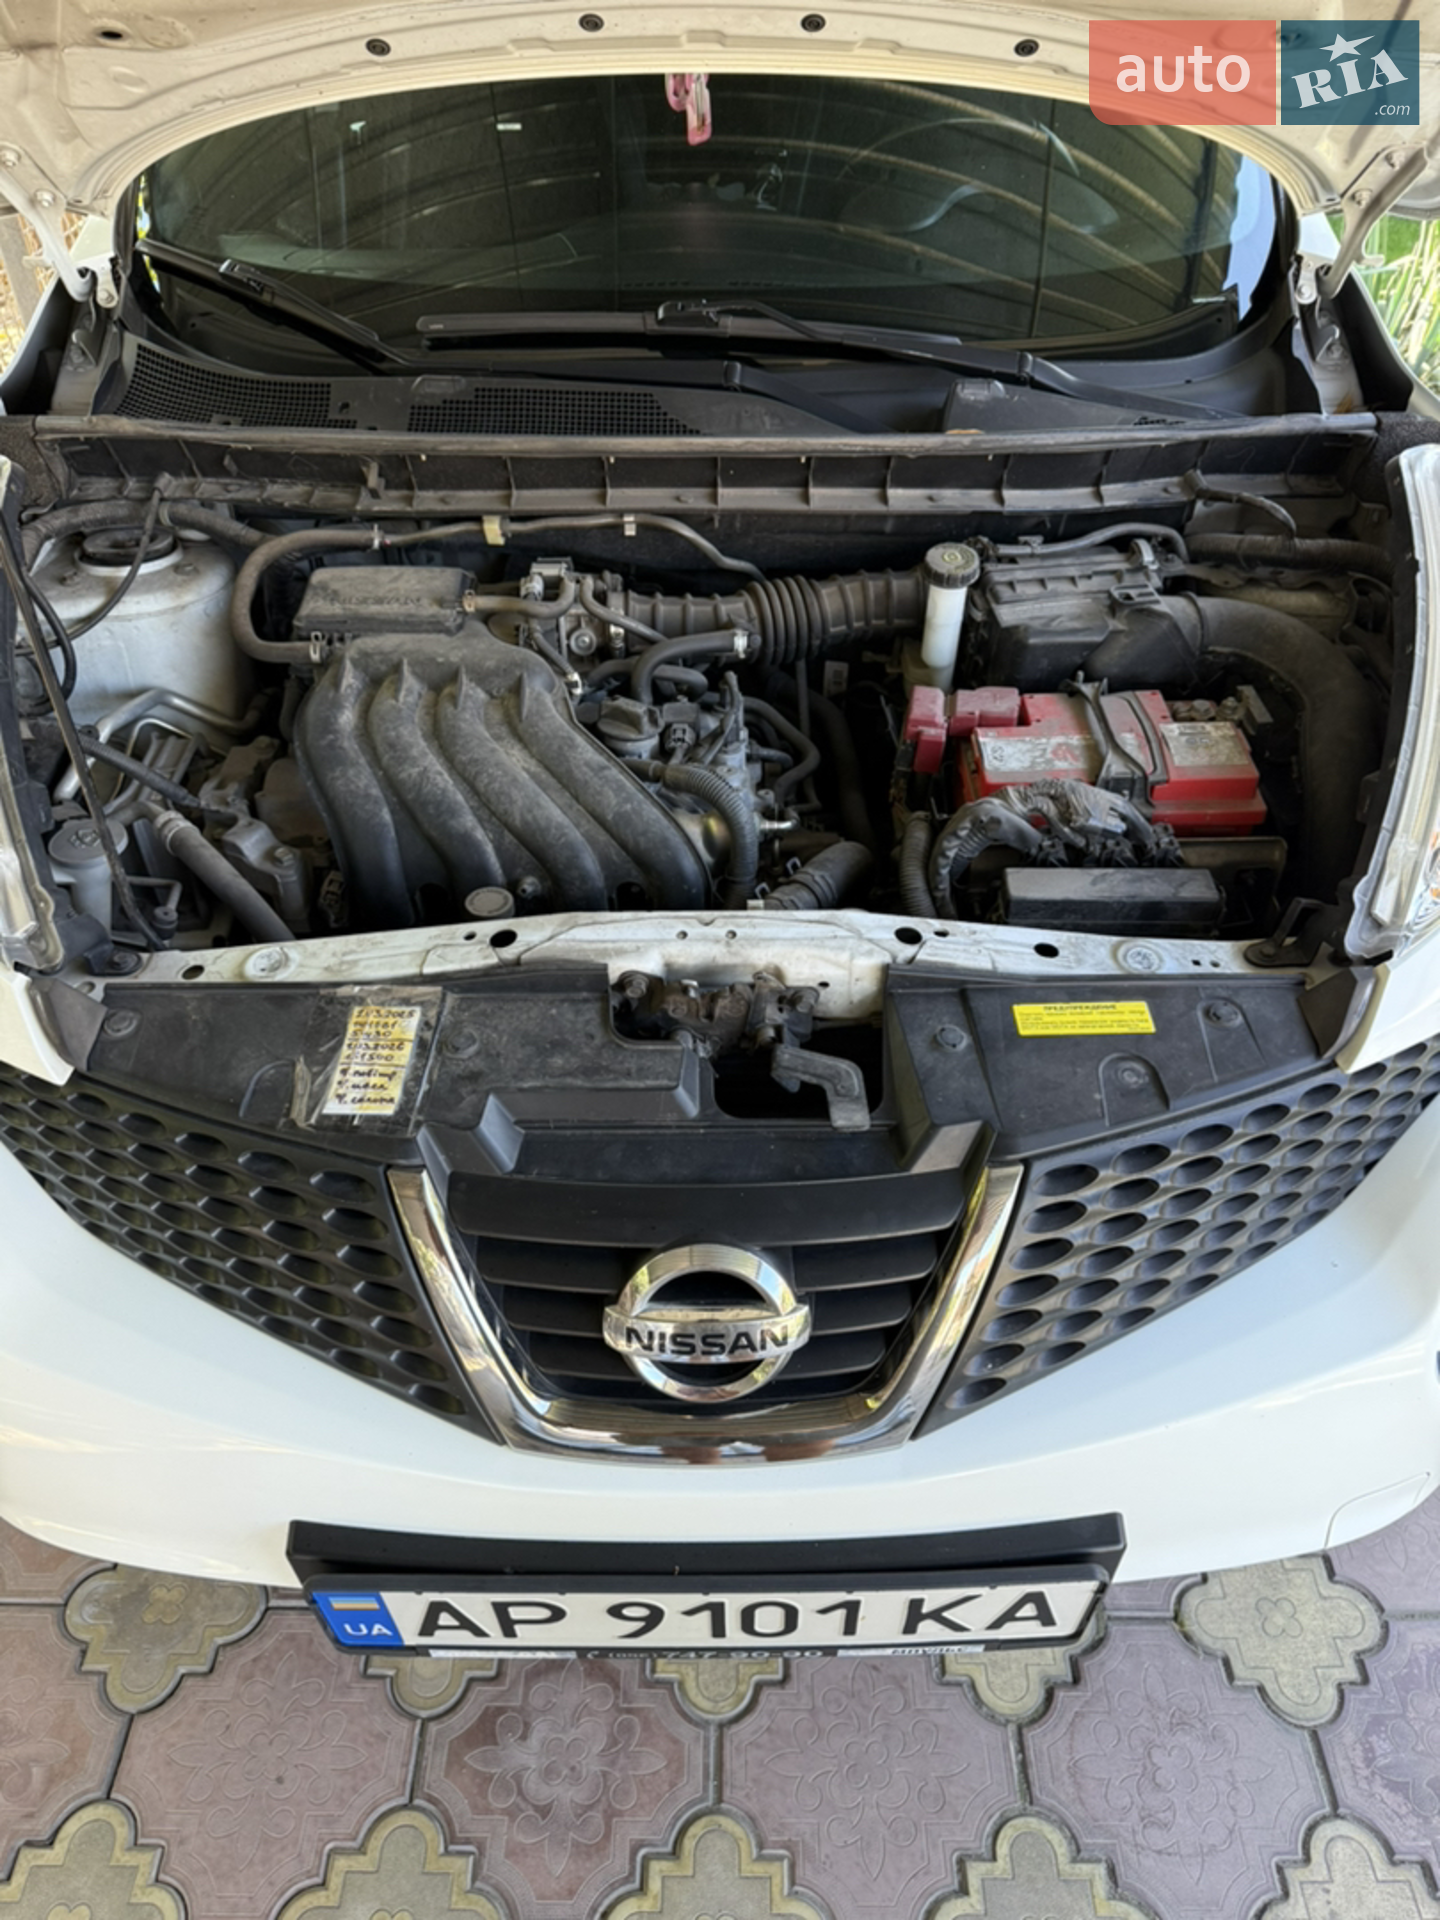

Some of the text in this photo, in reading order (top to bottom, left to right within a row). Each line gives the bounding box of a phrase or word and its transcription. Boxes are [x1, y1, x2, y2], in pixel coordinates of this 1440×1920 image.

[625, 1324, 788, 1356] NISSAN
[344, 1623, 393, 1637] UA
[418, 1591, 1057, 1639] AP 9101 KA
